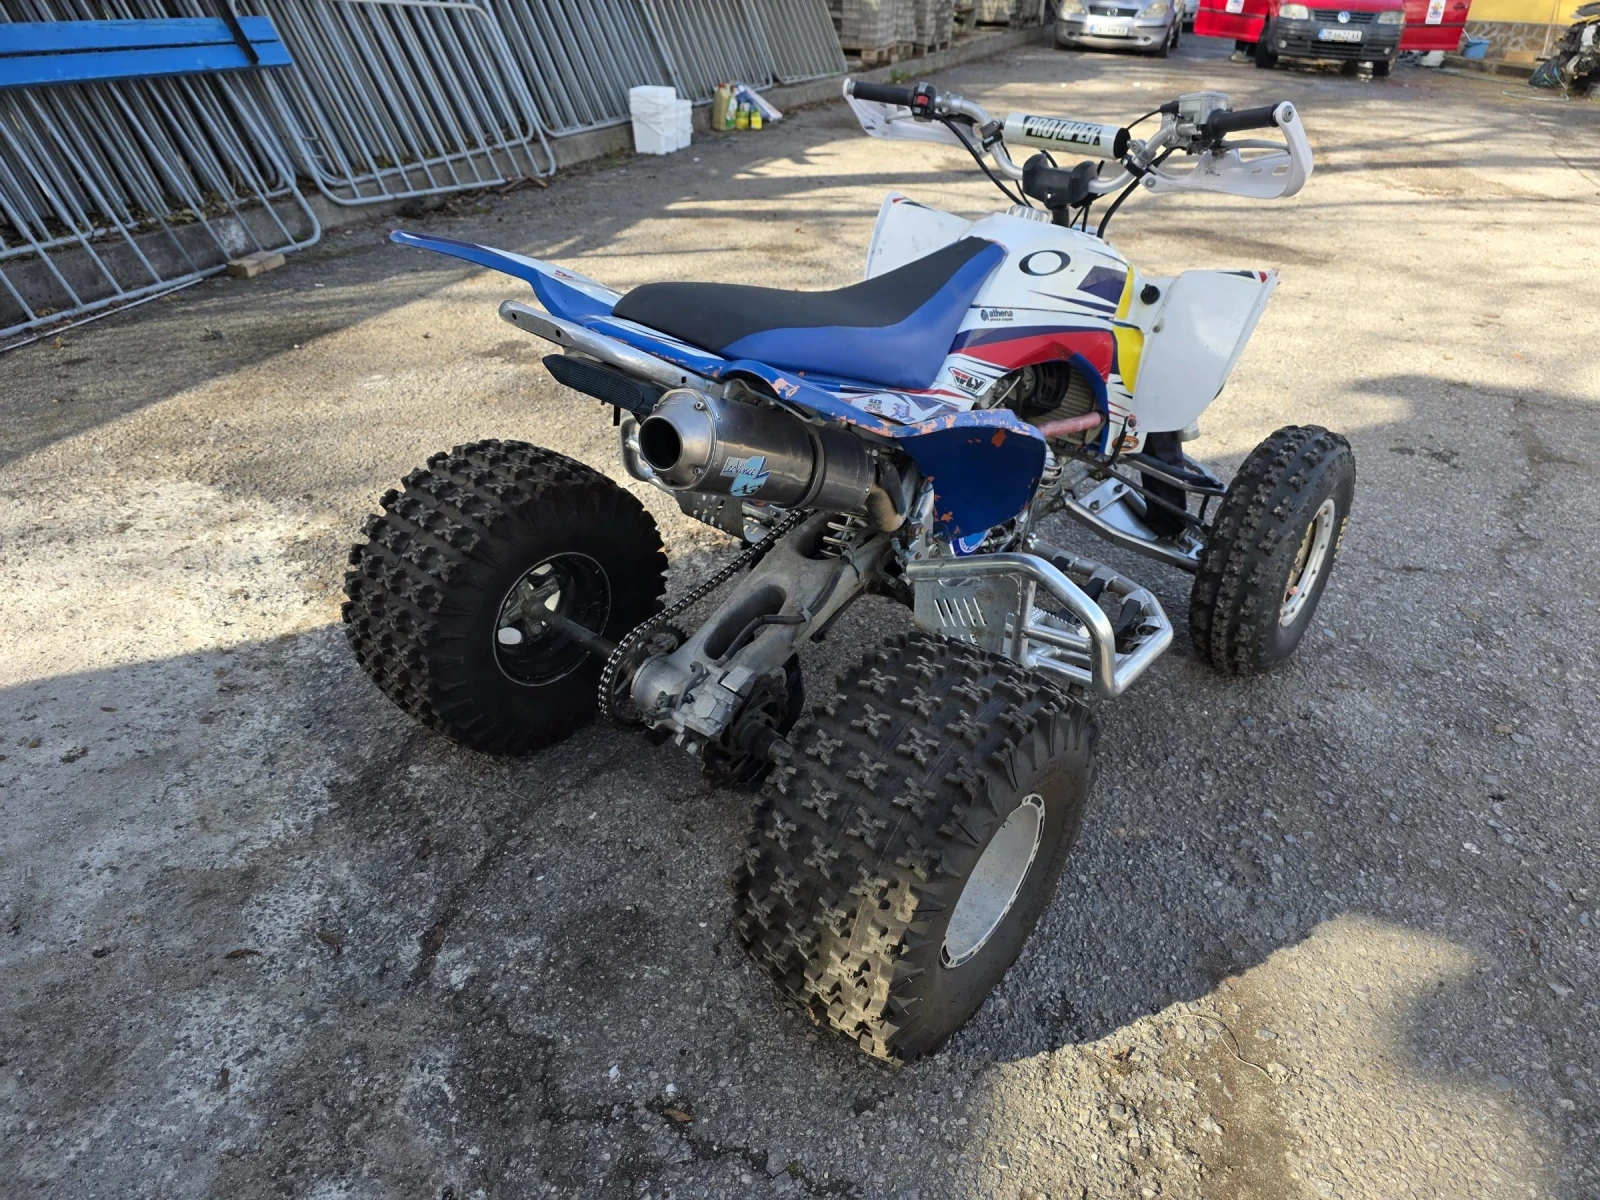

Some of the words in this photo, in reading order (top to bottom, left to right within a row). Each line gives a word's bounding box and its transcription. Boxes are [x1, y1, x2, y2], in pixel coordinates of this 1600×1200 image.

[1023, 117, 1102, 146] PROTAPER
[988, 308, 1014, 318] athena
[951, 369, 985, 391] FLY
